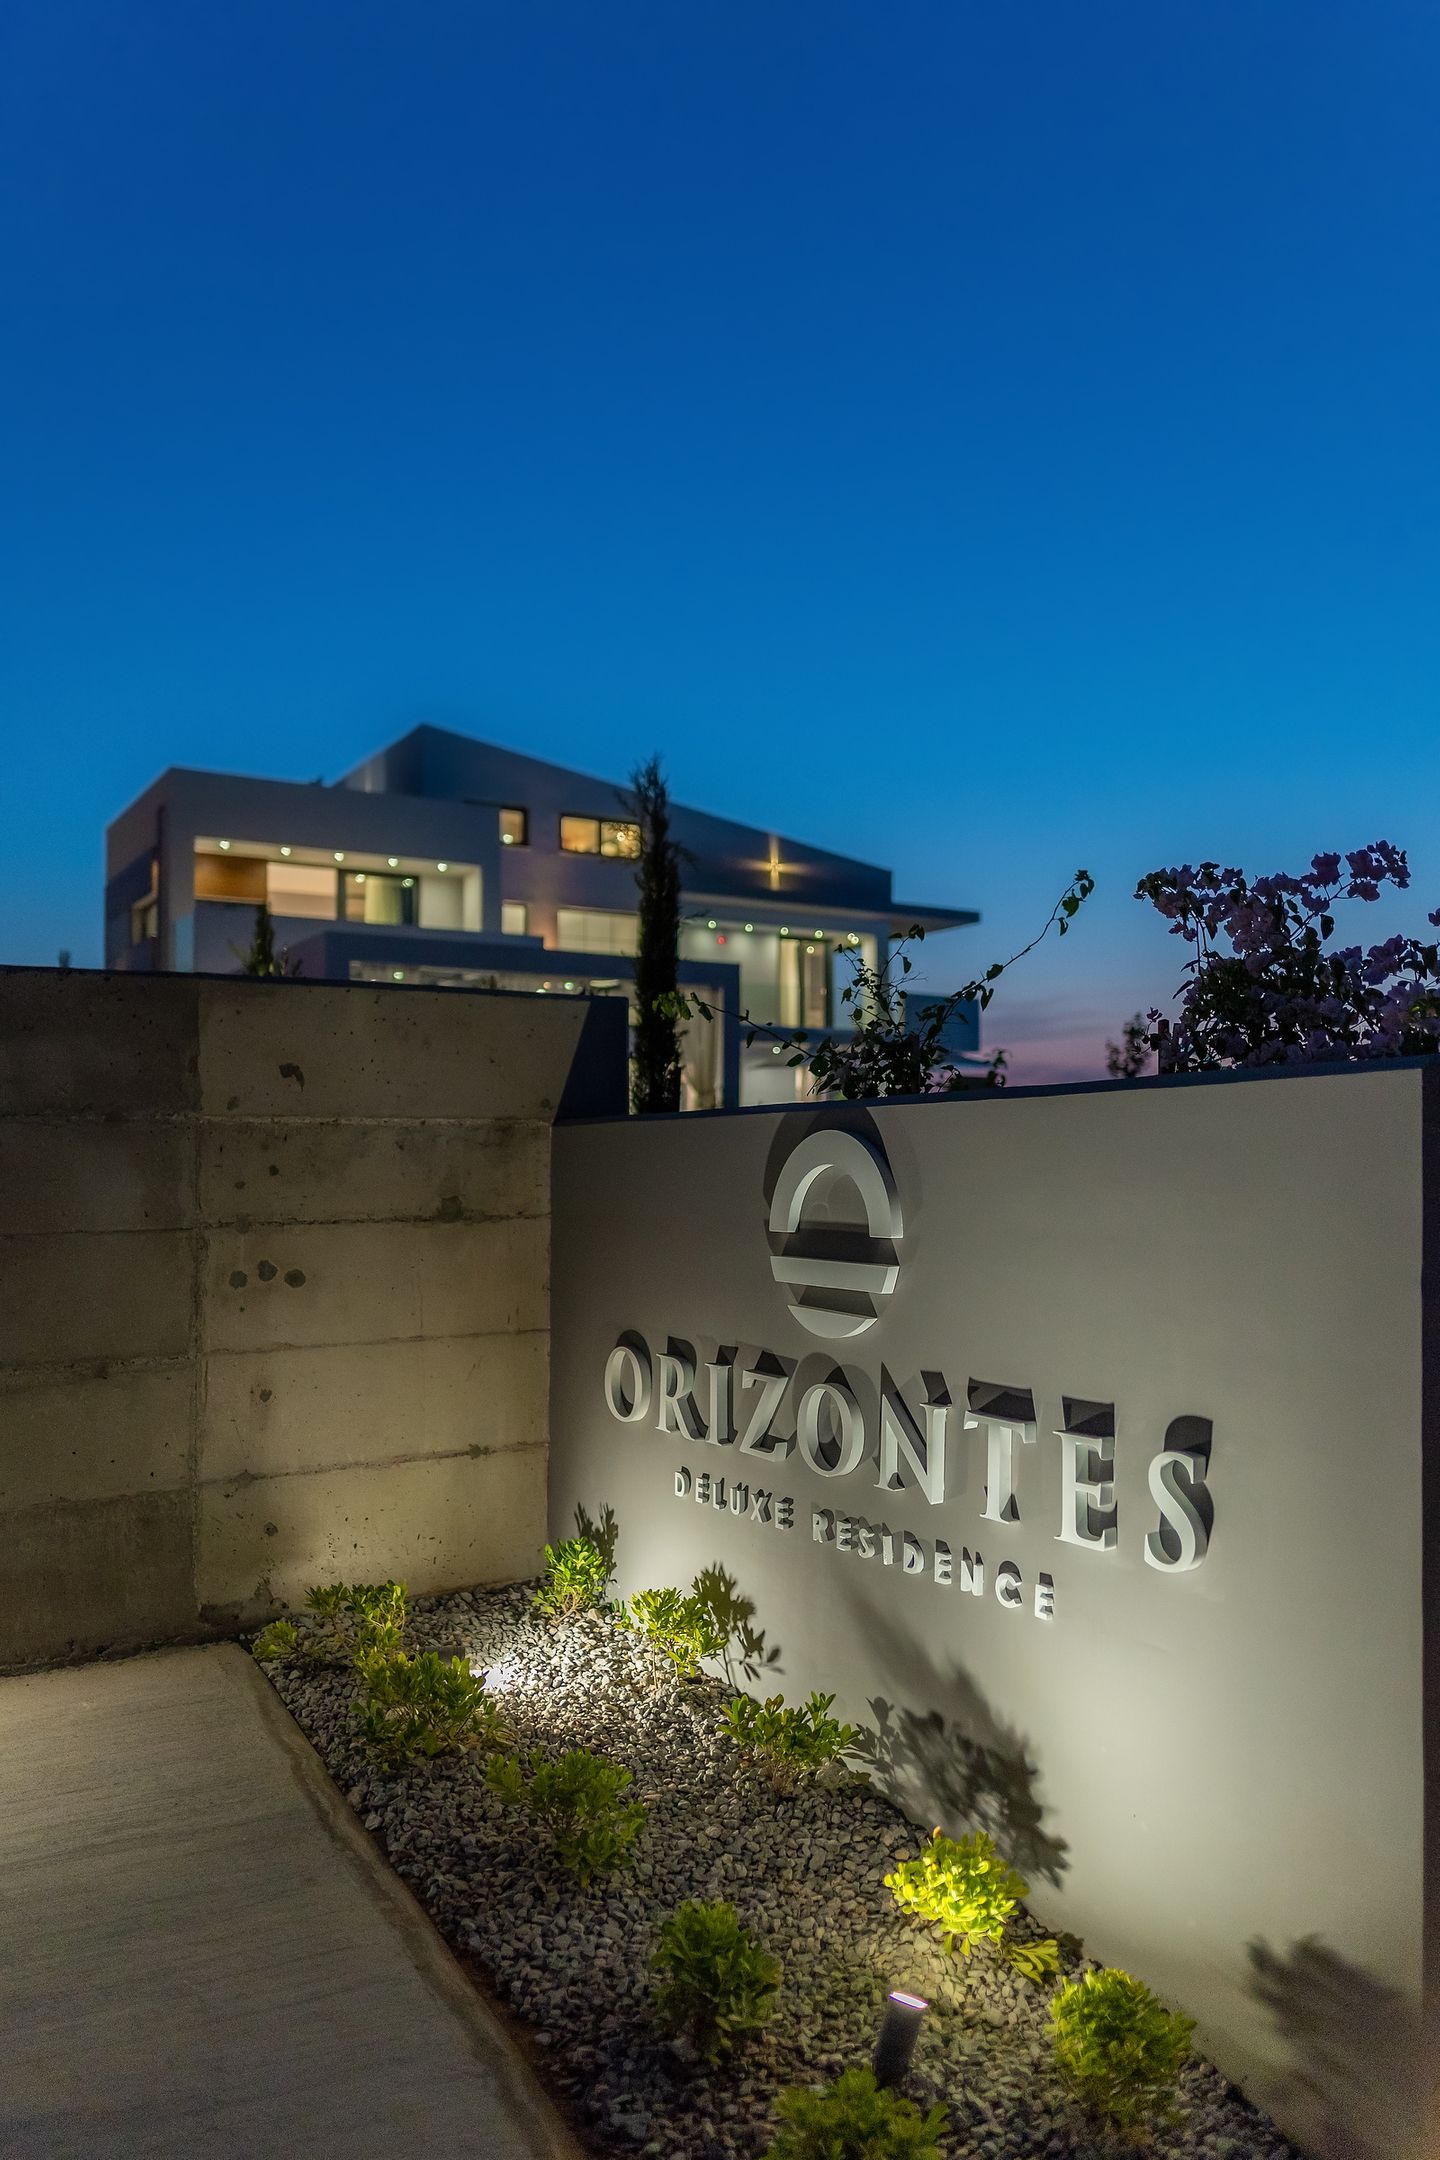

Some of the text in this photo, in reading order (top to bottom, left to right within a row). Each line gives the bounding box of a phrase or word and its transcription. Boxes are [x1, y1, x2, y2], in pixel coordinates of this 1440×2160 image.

[604, 1345, 1209, 1573] ORIZONTES
[674, 1467, 1055, 1620] DELUXE RESIDENCE
